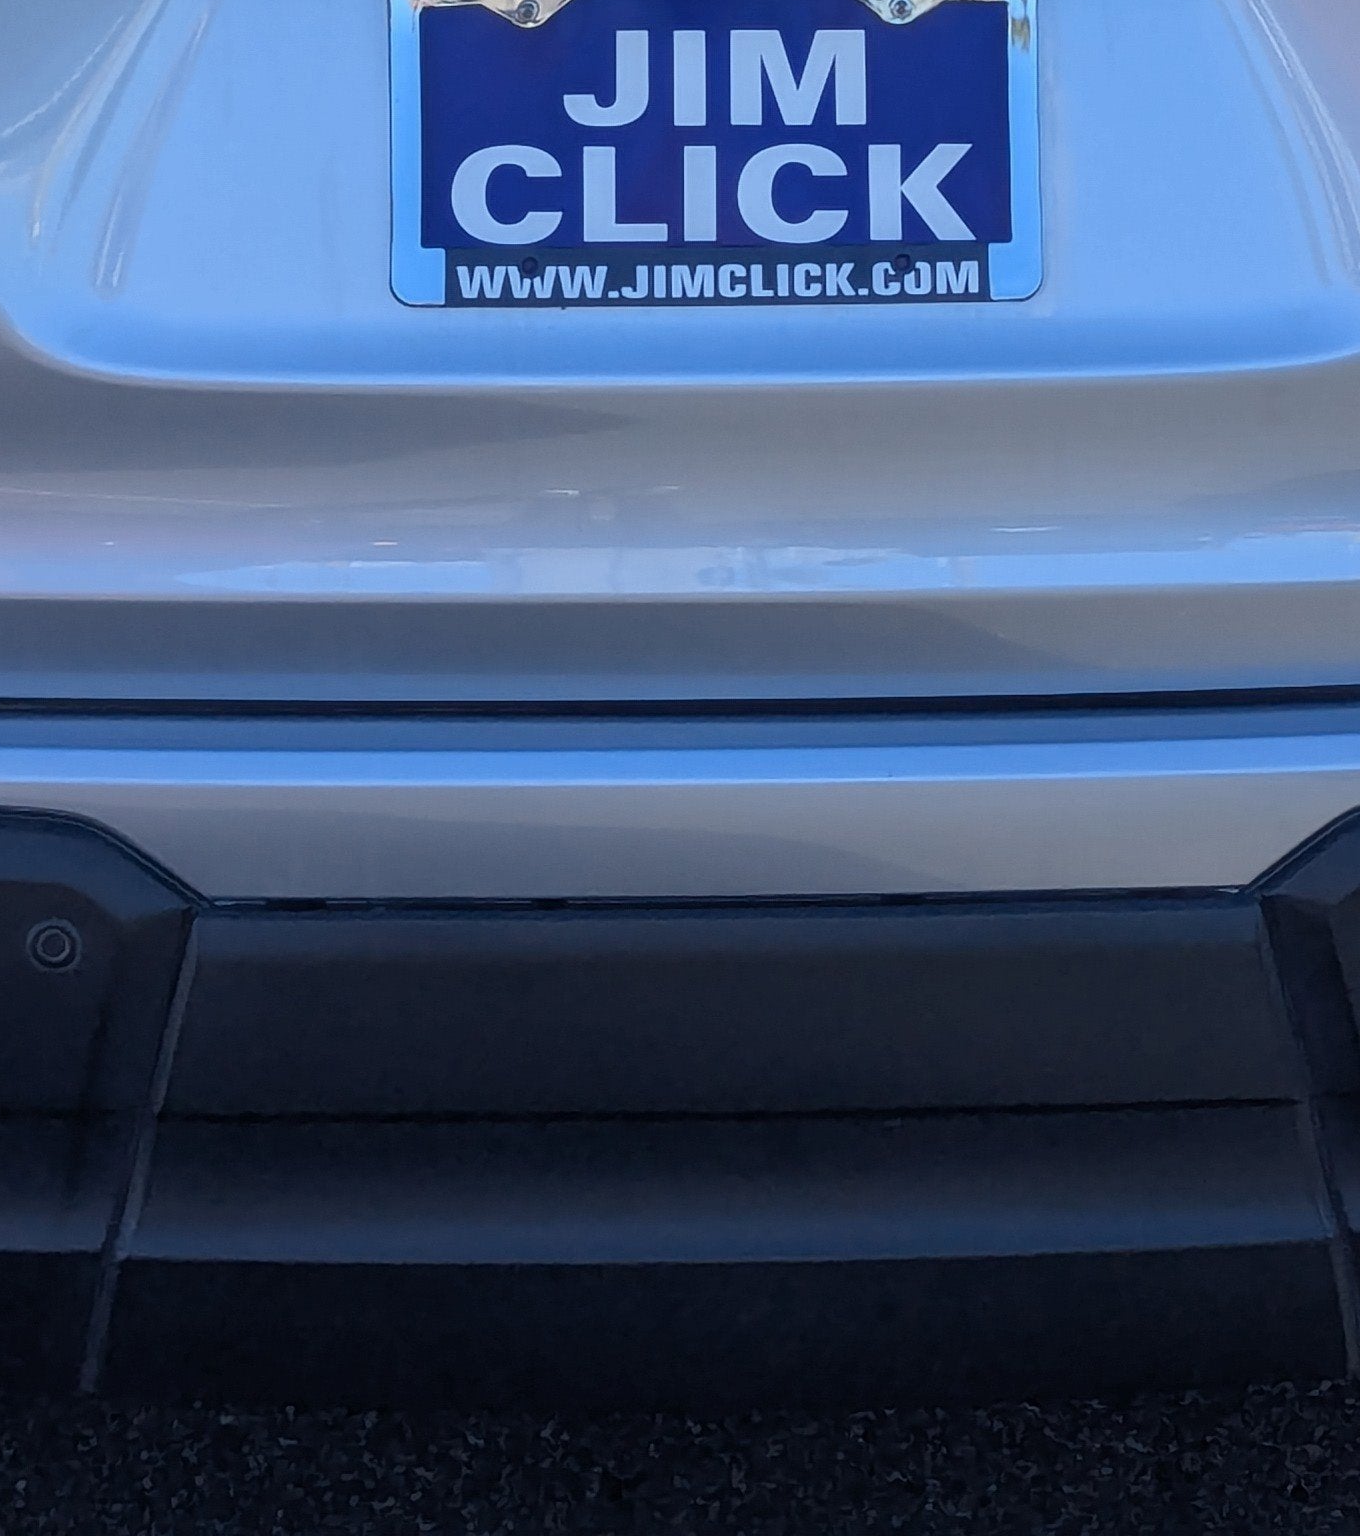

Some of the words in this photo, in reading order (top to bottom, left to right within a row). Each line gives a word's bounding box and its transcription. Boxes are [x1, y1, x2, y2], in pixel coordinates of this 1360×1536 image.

[562, 28, 867, 127] JIM
[449, 142, 977, 245] CLICK
[455, 260, 980, 300] WWW.JIMCLICK.COM
